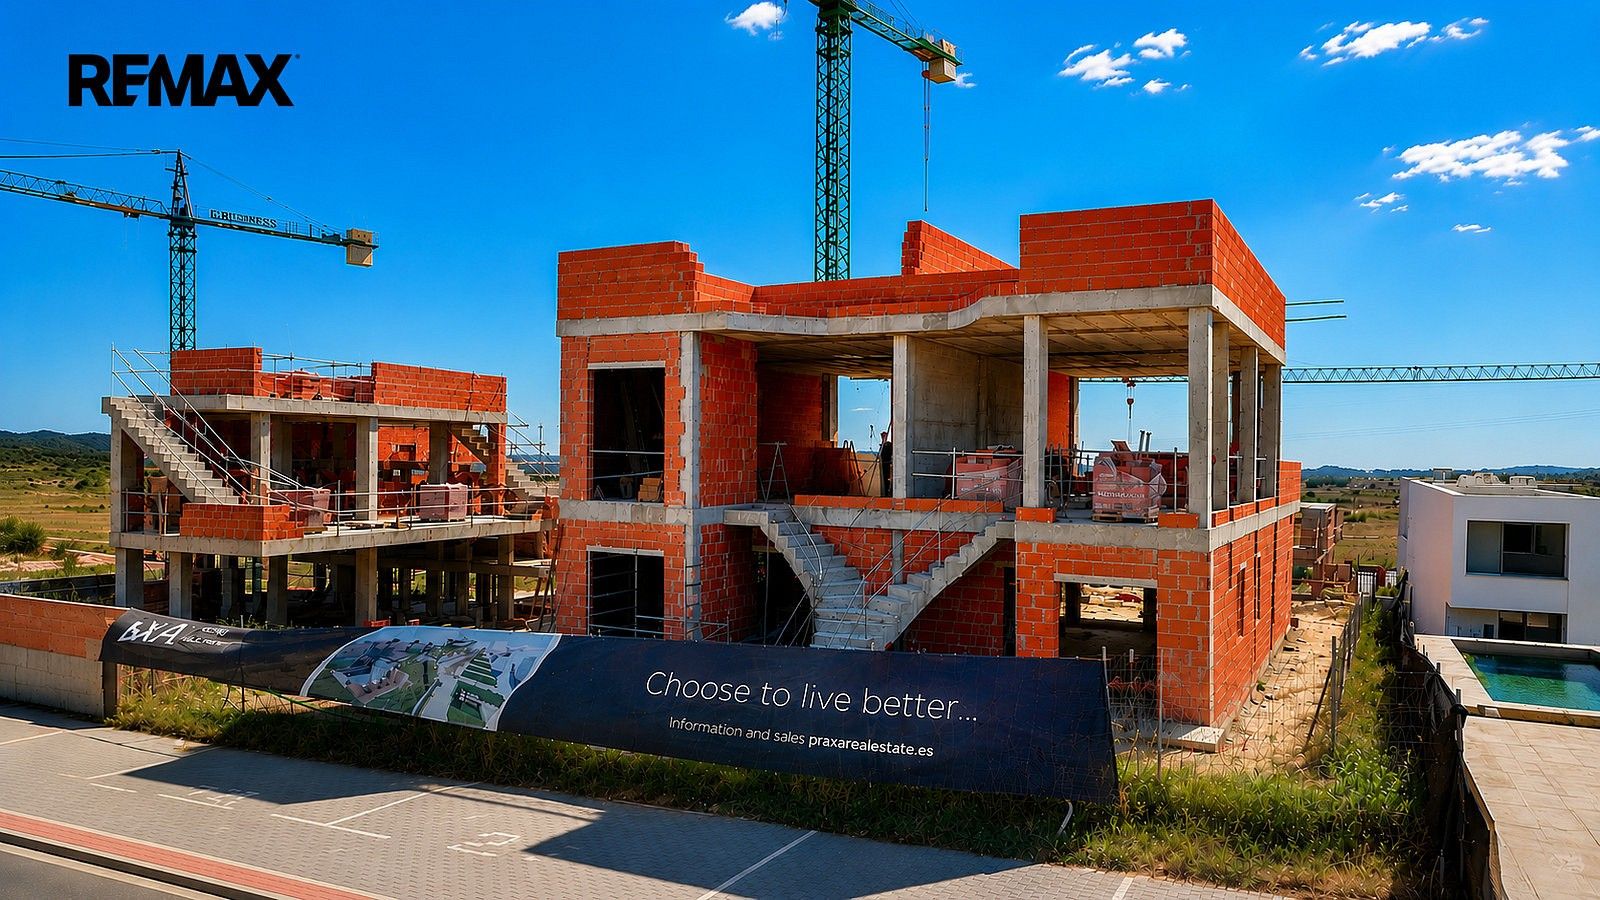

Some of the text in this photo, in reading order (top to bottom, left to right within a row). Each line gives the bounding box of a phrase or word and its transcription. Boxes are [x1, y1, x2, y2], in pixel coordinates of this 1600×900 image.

[646, 671, 977, 721] Choose to live better...
[668, 716, 934, 757] Information and sales praxarealestate.es
